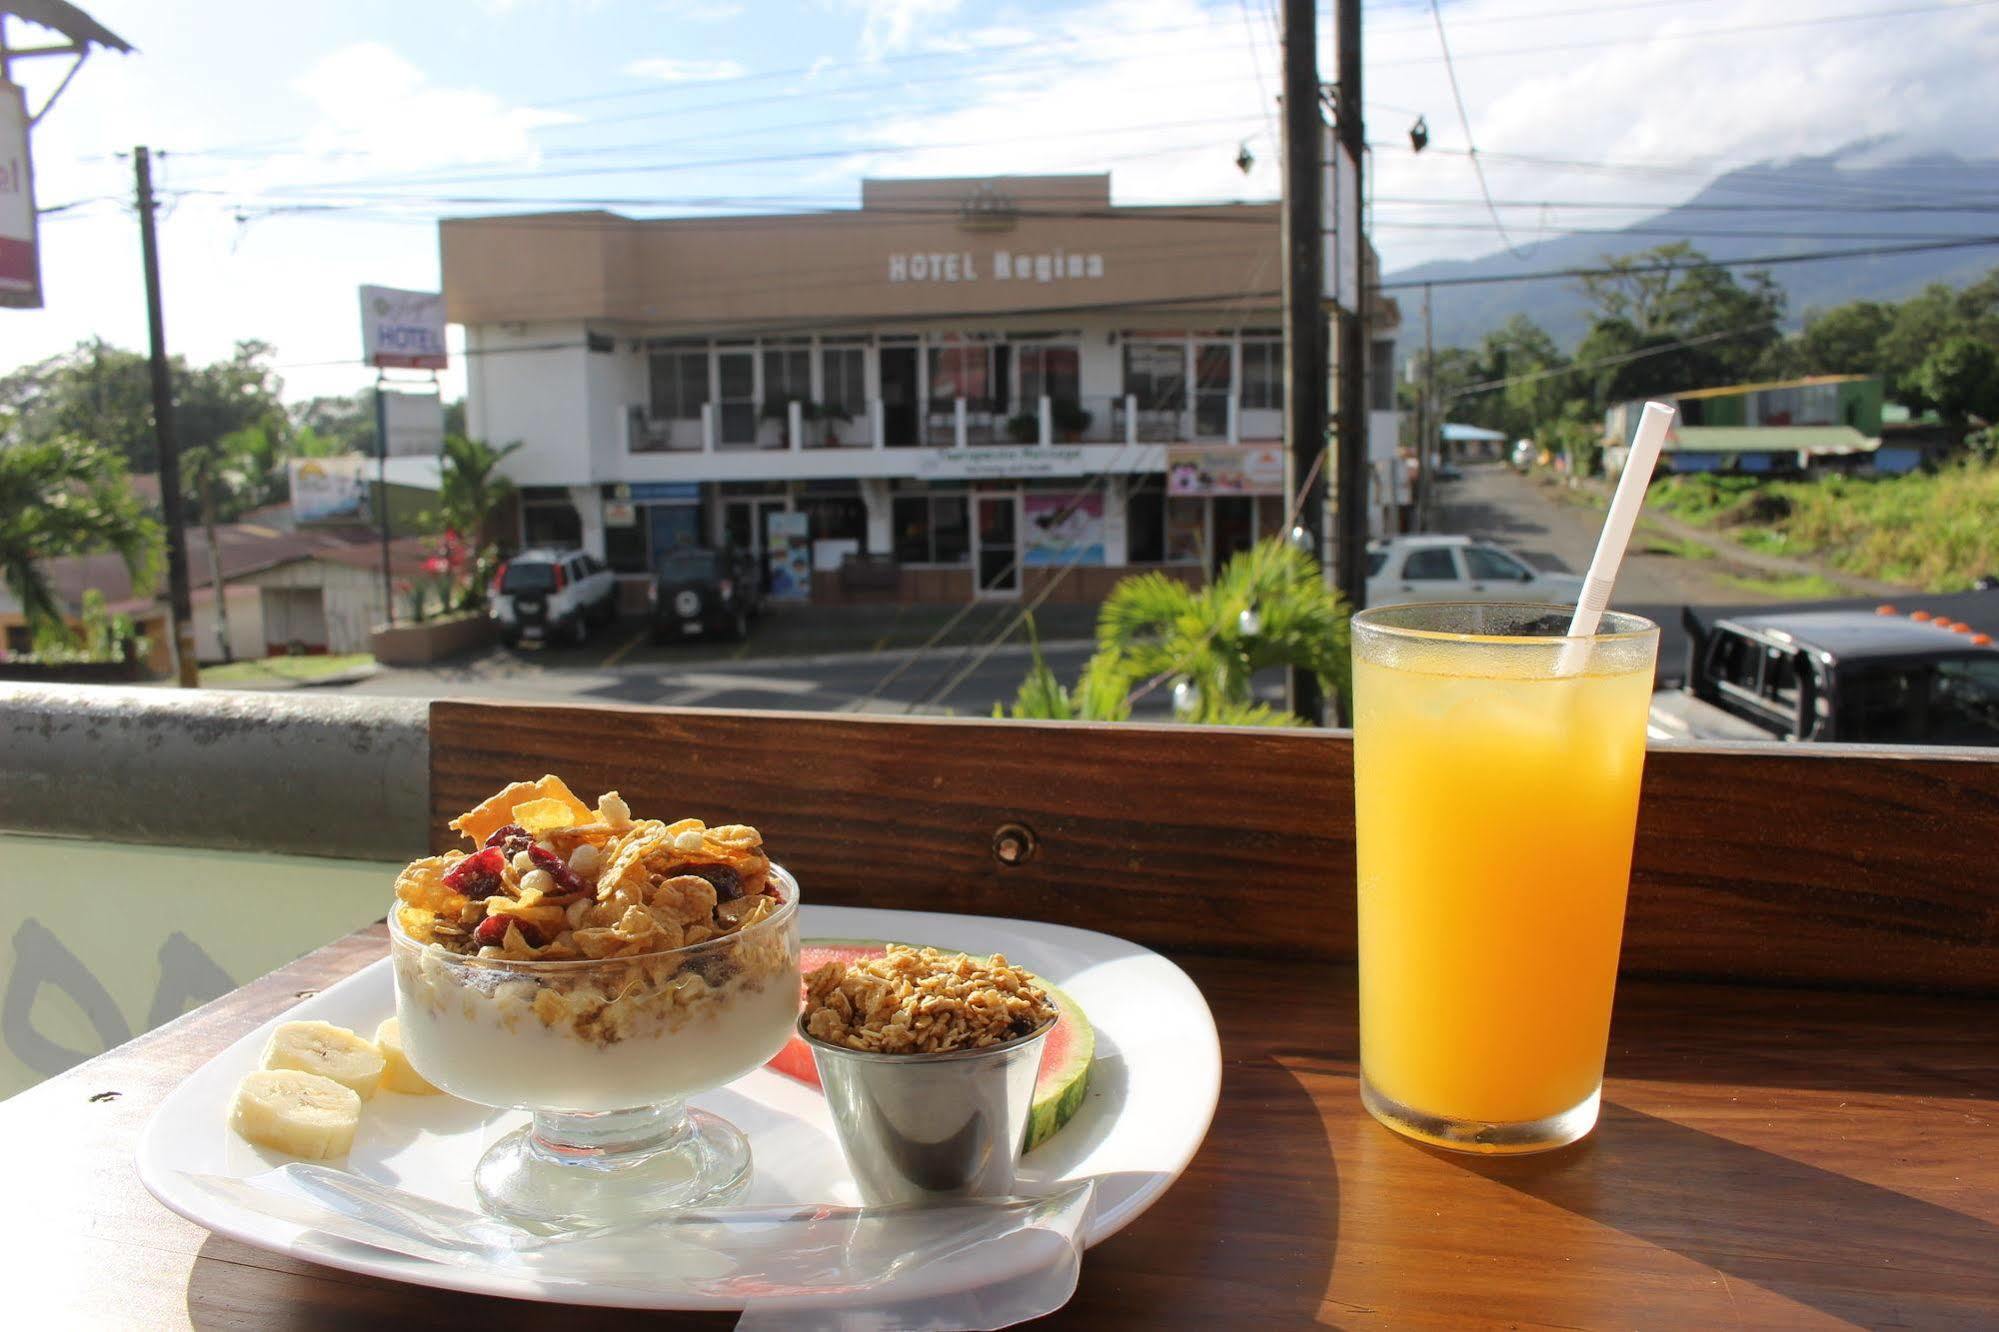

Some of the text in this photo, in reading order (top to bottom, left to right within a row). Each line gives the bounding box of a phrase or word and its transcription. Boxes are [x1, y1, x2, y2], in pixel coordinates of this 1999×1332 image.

[888, 249, 1104, 283] HOTEL Regina
[377, 325, 443, 352] HOTEL
